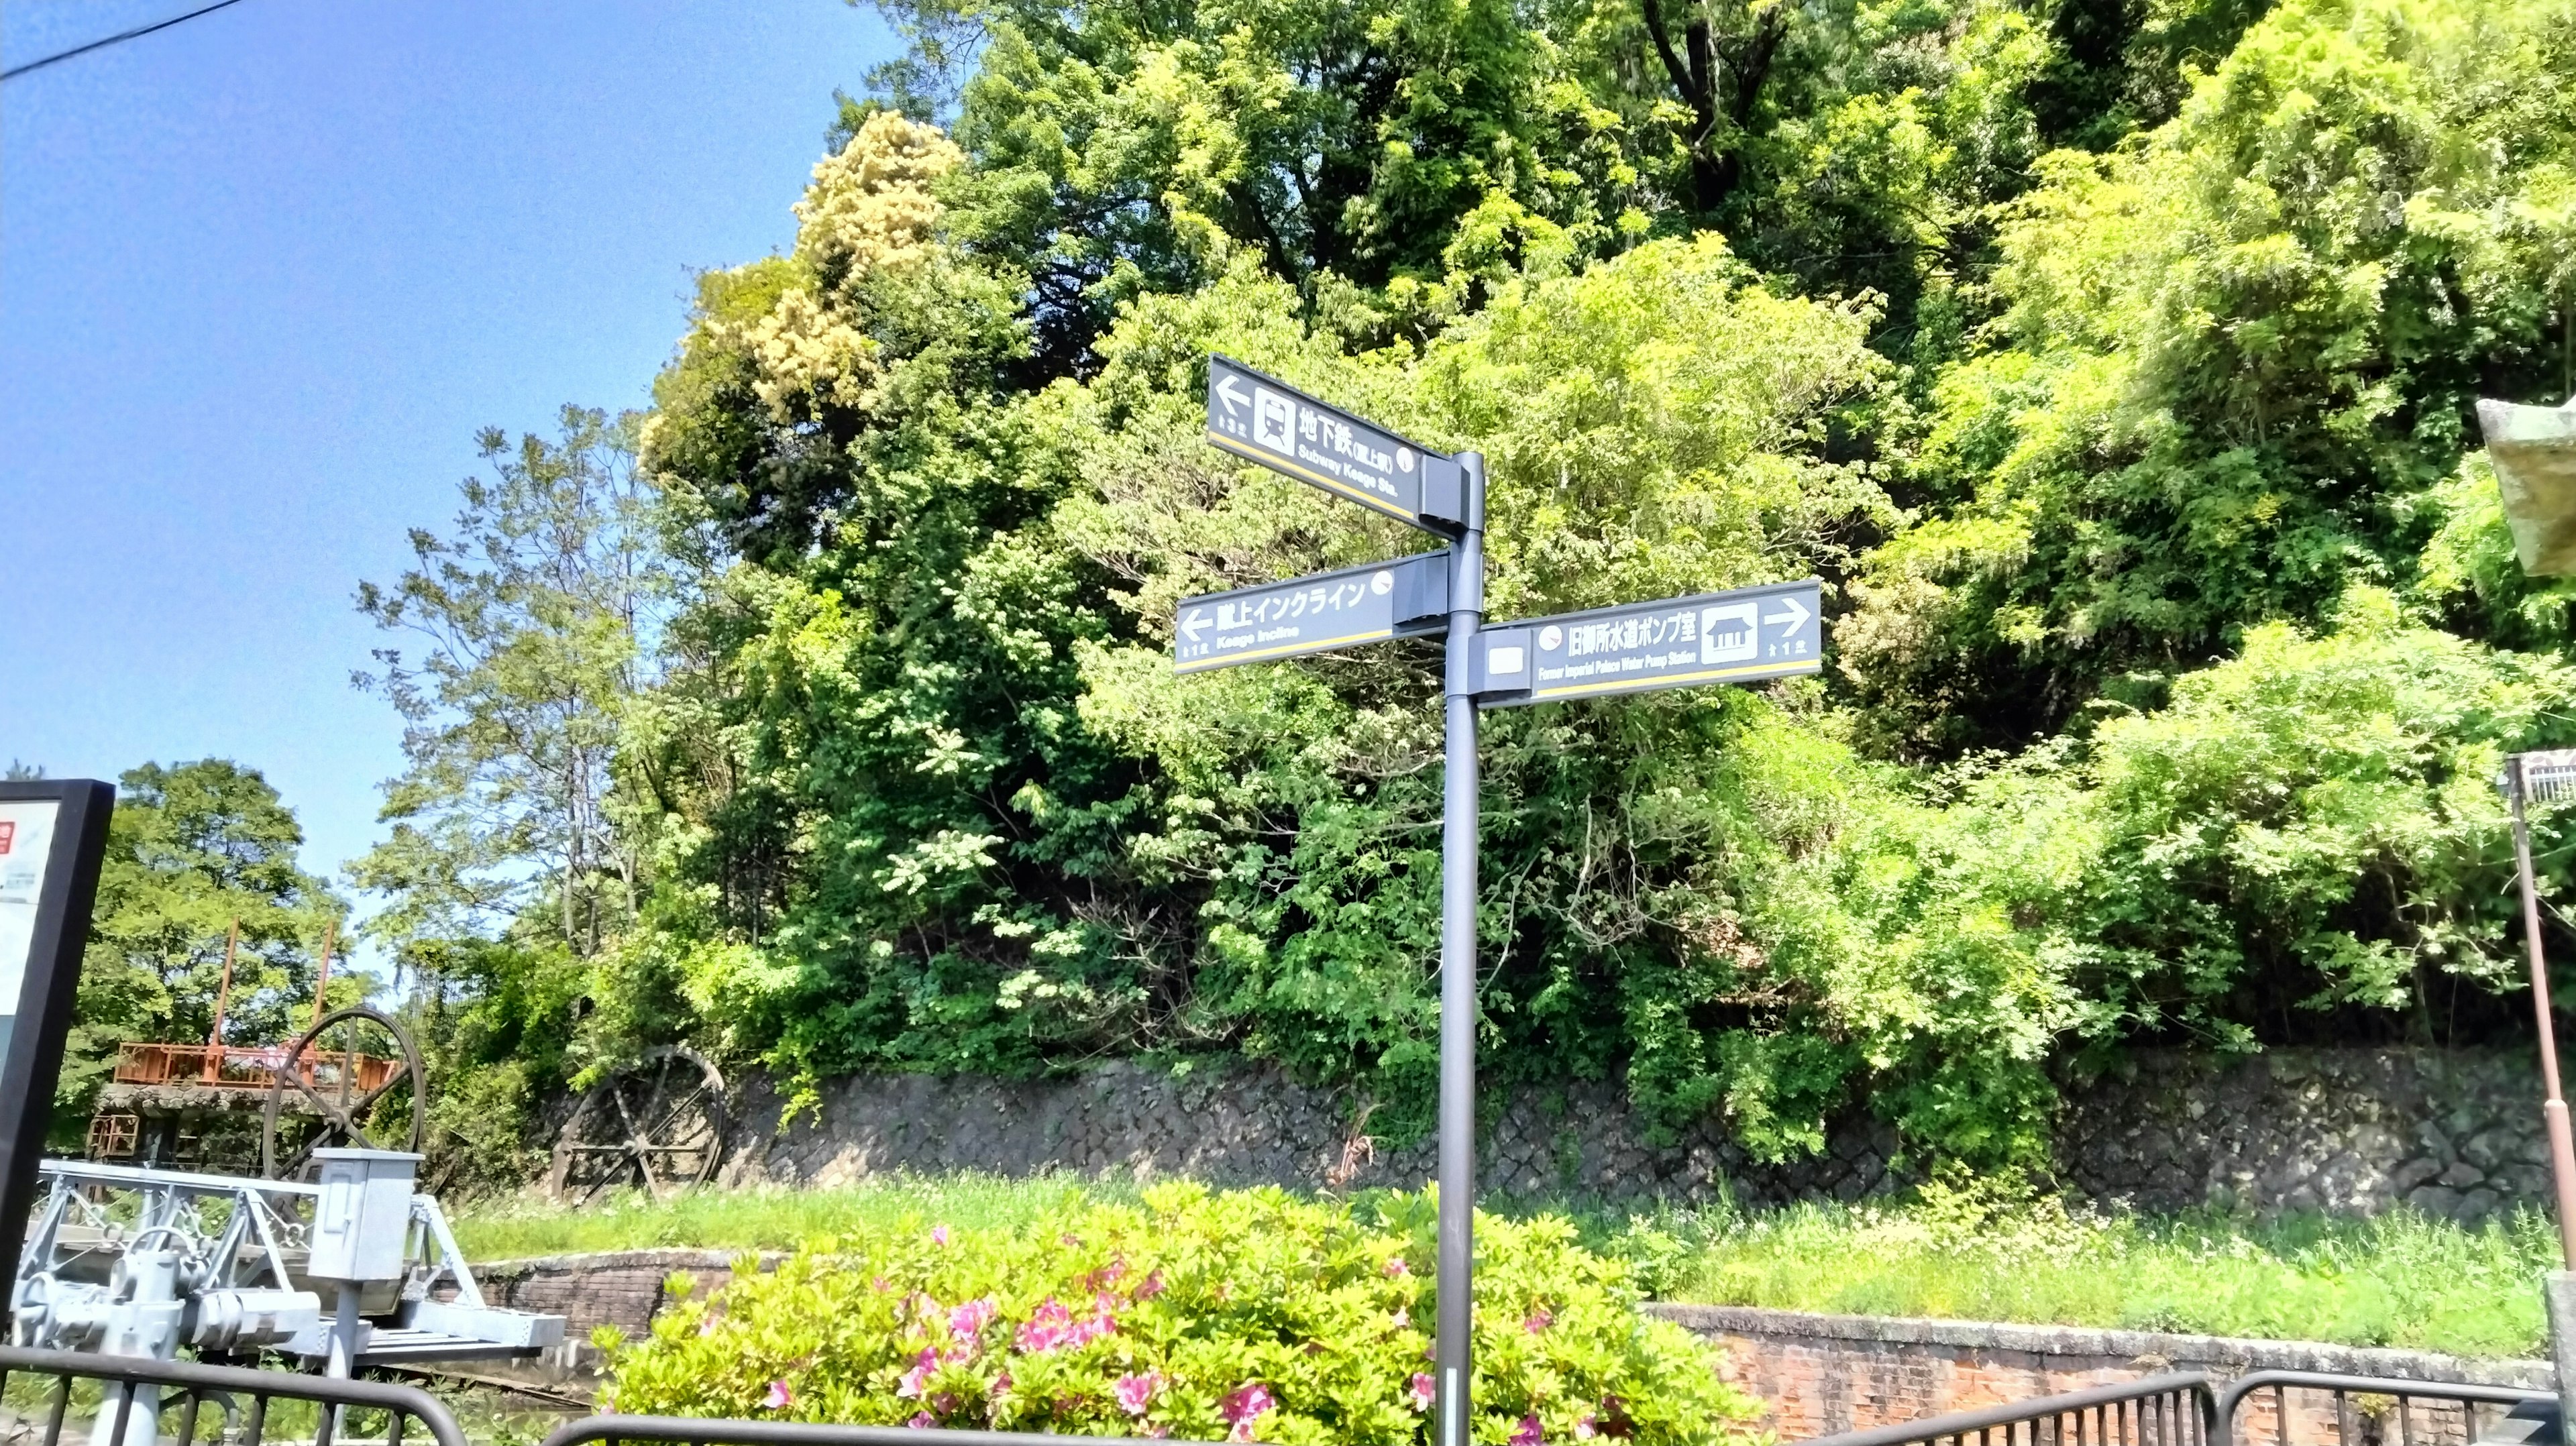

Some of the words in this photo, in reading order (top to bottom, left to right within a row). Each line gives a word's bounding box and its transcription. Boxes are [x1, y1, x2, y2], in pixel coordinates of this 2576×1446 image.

[1298, 444, 1342, 476] Subway
[1378, 477, 1398, 497] Sta.
[1257, 626, 1299, 643] Incline
[1568, 611, 1697, 657] 旧御所水道ポンプ室
[1782, 641, 1790, 655] 1
[1538, 665, 1564, 681] Former
[1565, 661, 1595, 679] Imperial
[1596, 659, 1621, 674] Palace
[1621, 657, 1644, 671] Water
[1645, 654, 1667, 669] Pump
[1668, 650, 1697, 666] Station
